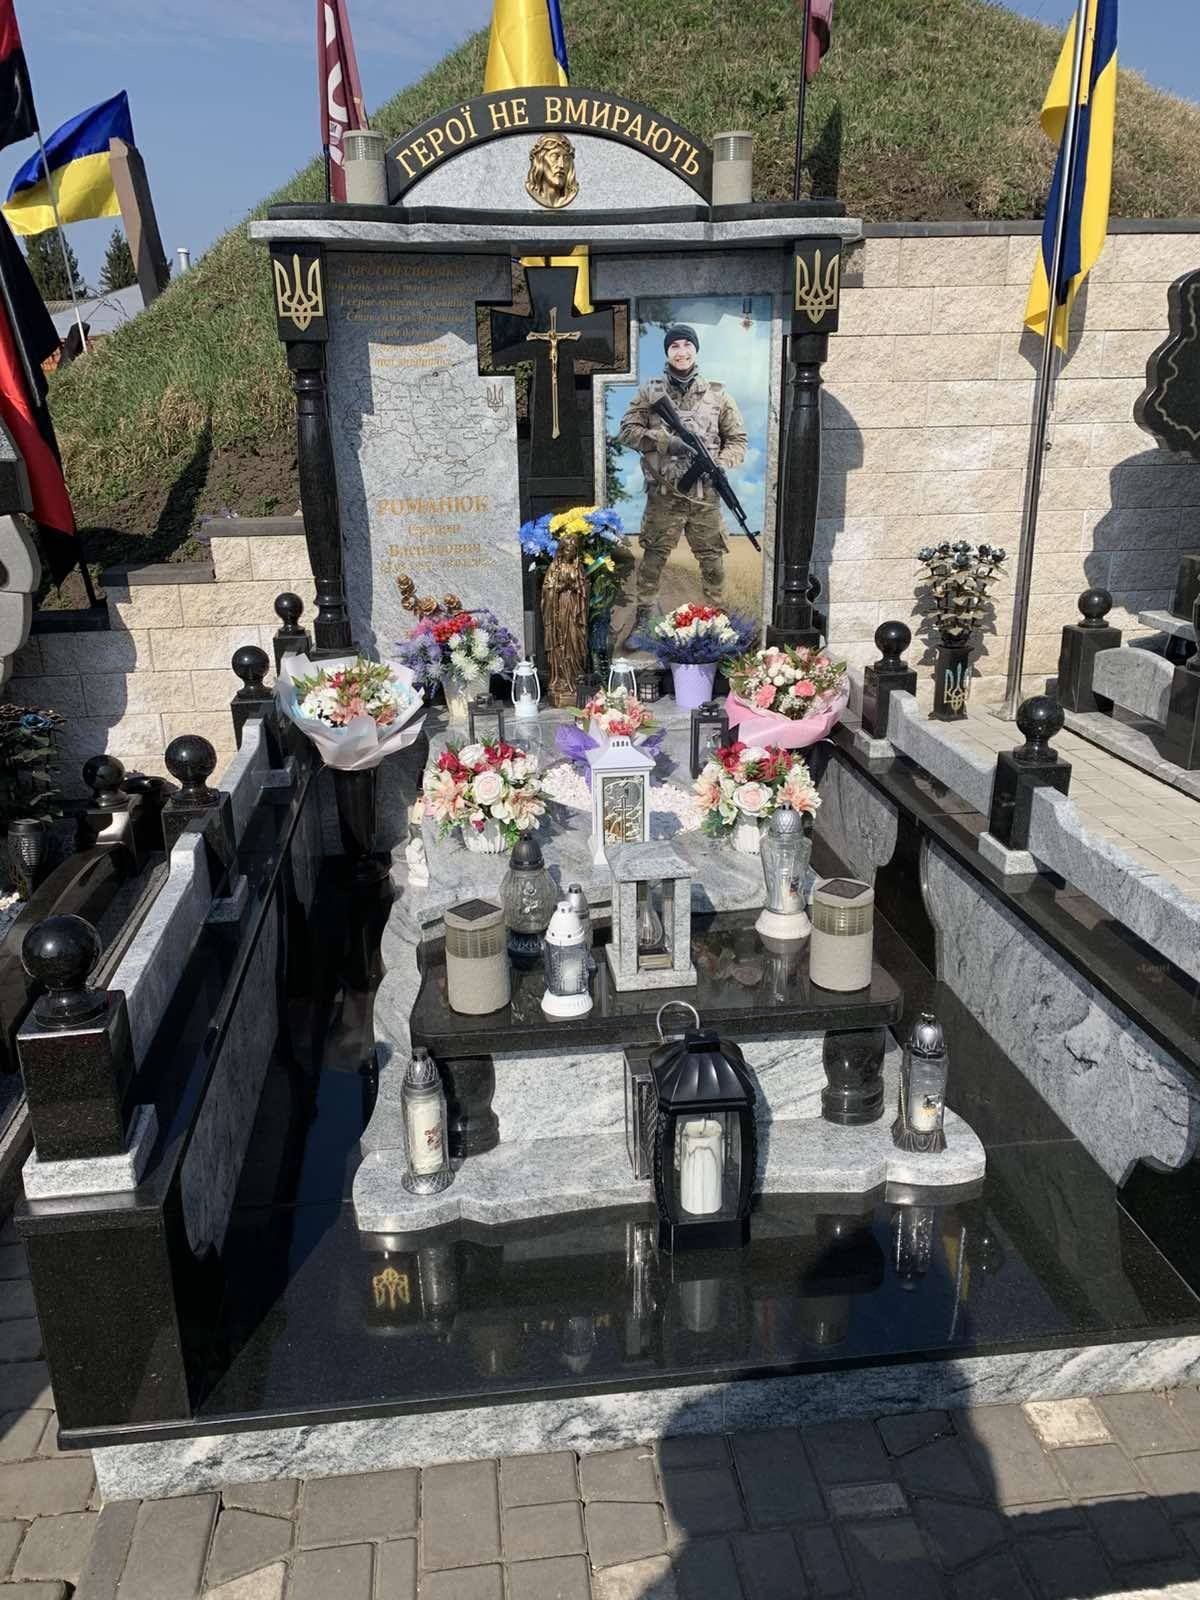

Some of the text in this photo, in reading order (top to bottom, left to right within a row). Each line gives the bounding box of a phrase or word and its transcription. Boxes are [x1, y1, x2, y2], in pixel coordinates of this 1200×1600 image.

[396, 96, 700, 178] ГЕРОЇ НЕ ВМИРАЮТЬ
